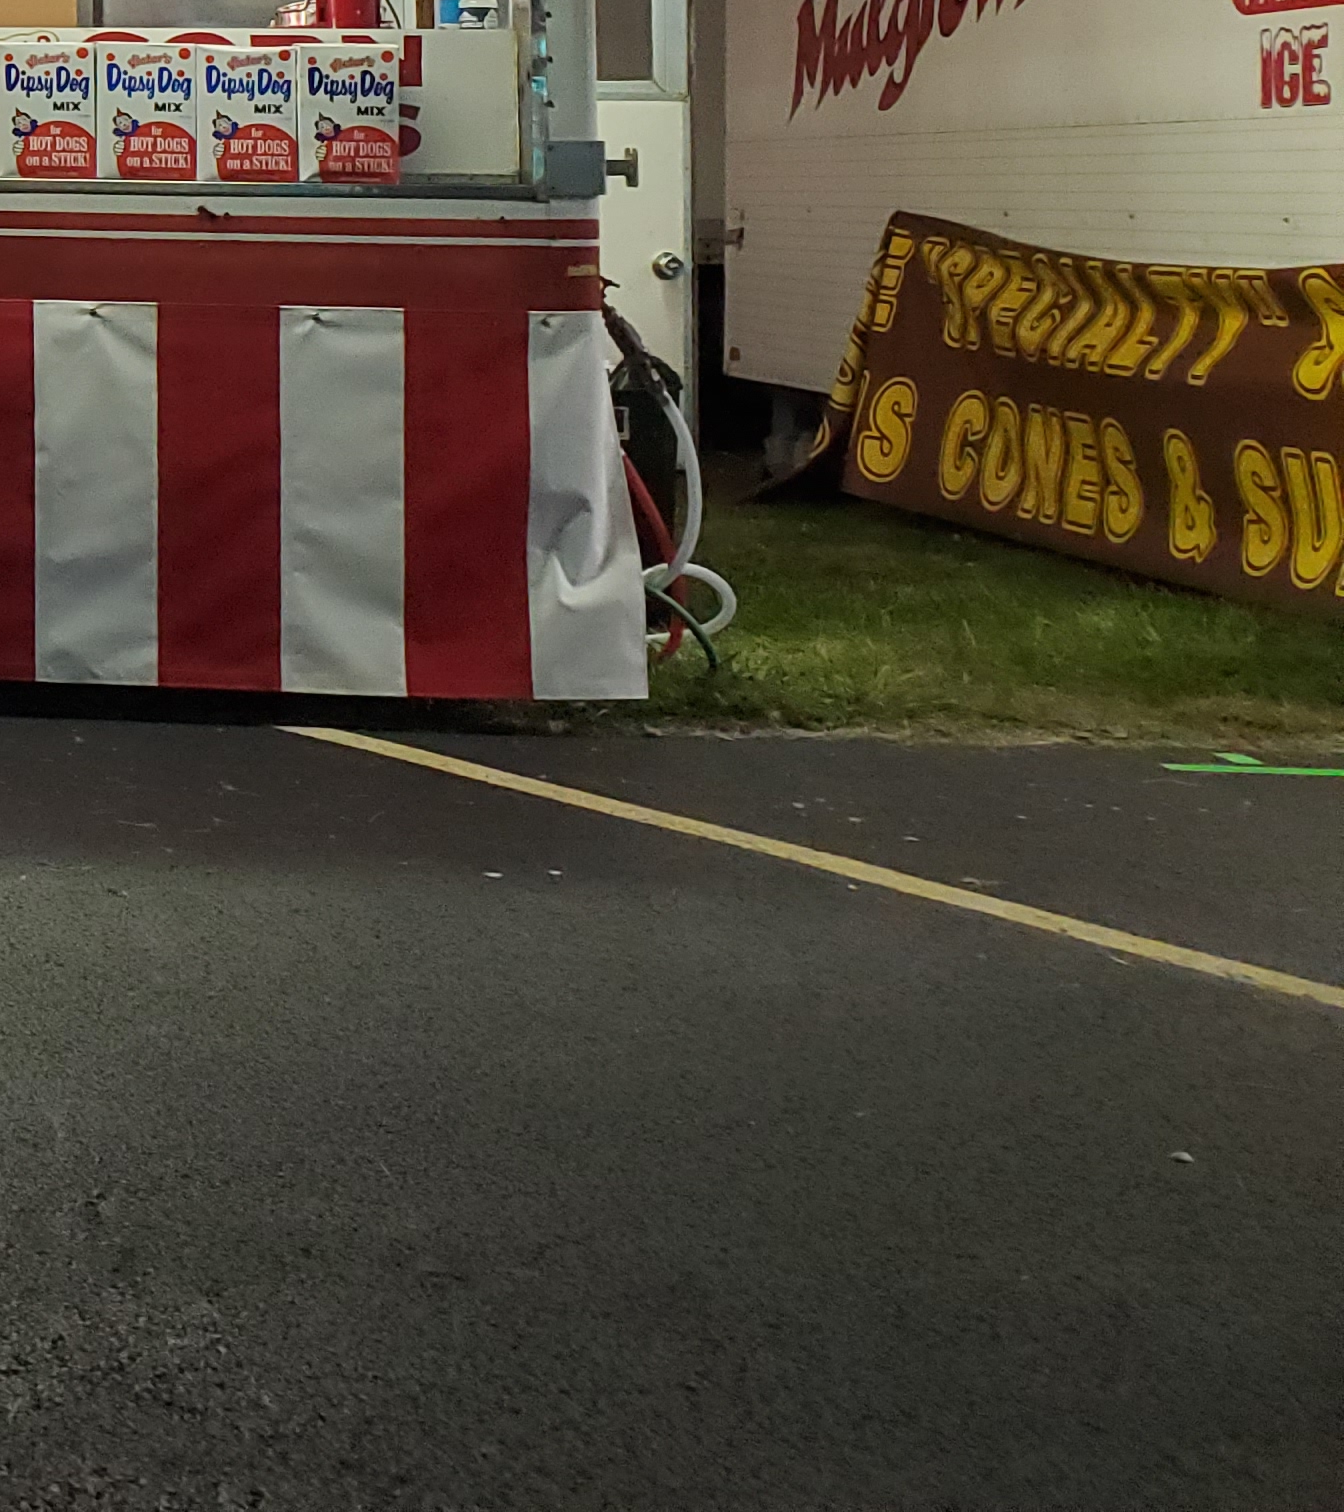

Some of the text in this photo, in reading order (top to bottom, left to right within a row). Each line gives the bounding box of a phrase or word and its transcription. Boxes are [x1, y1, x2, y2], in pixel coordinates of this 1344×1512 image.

[1260, 22, 1331, 109] ICE
[5, 63, 90, 100] Dipsy Dog
[106, 63, 192, 101] Dipsy Dog
[206, 65, 292, 102] Dipsy Dog
[360, 70, 394, 104] Dog
[52, 102, 82, 112] MIX
[154, 102, 182, 113] MIX
[254, 104, 283, 114] MIX
[356, 106, 386, 116] MIX
[29, 137, 88, 152] HOT DOGS
[130, 138, 188, 152] HOT DOGS
[230, 140, 289, 154] HOT DOGS
[51, 152, 90, 167] STICK!
[152, 154, 190, 168] STICK!
[252, 156, 292, 171] STICK!
[939, 389, 1142, 544] CONES
[1163, 428, 1217, 563] &
[1234, 439, 1344, 596] SU
